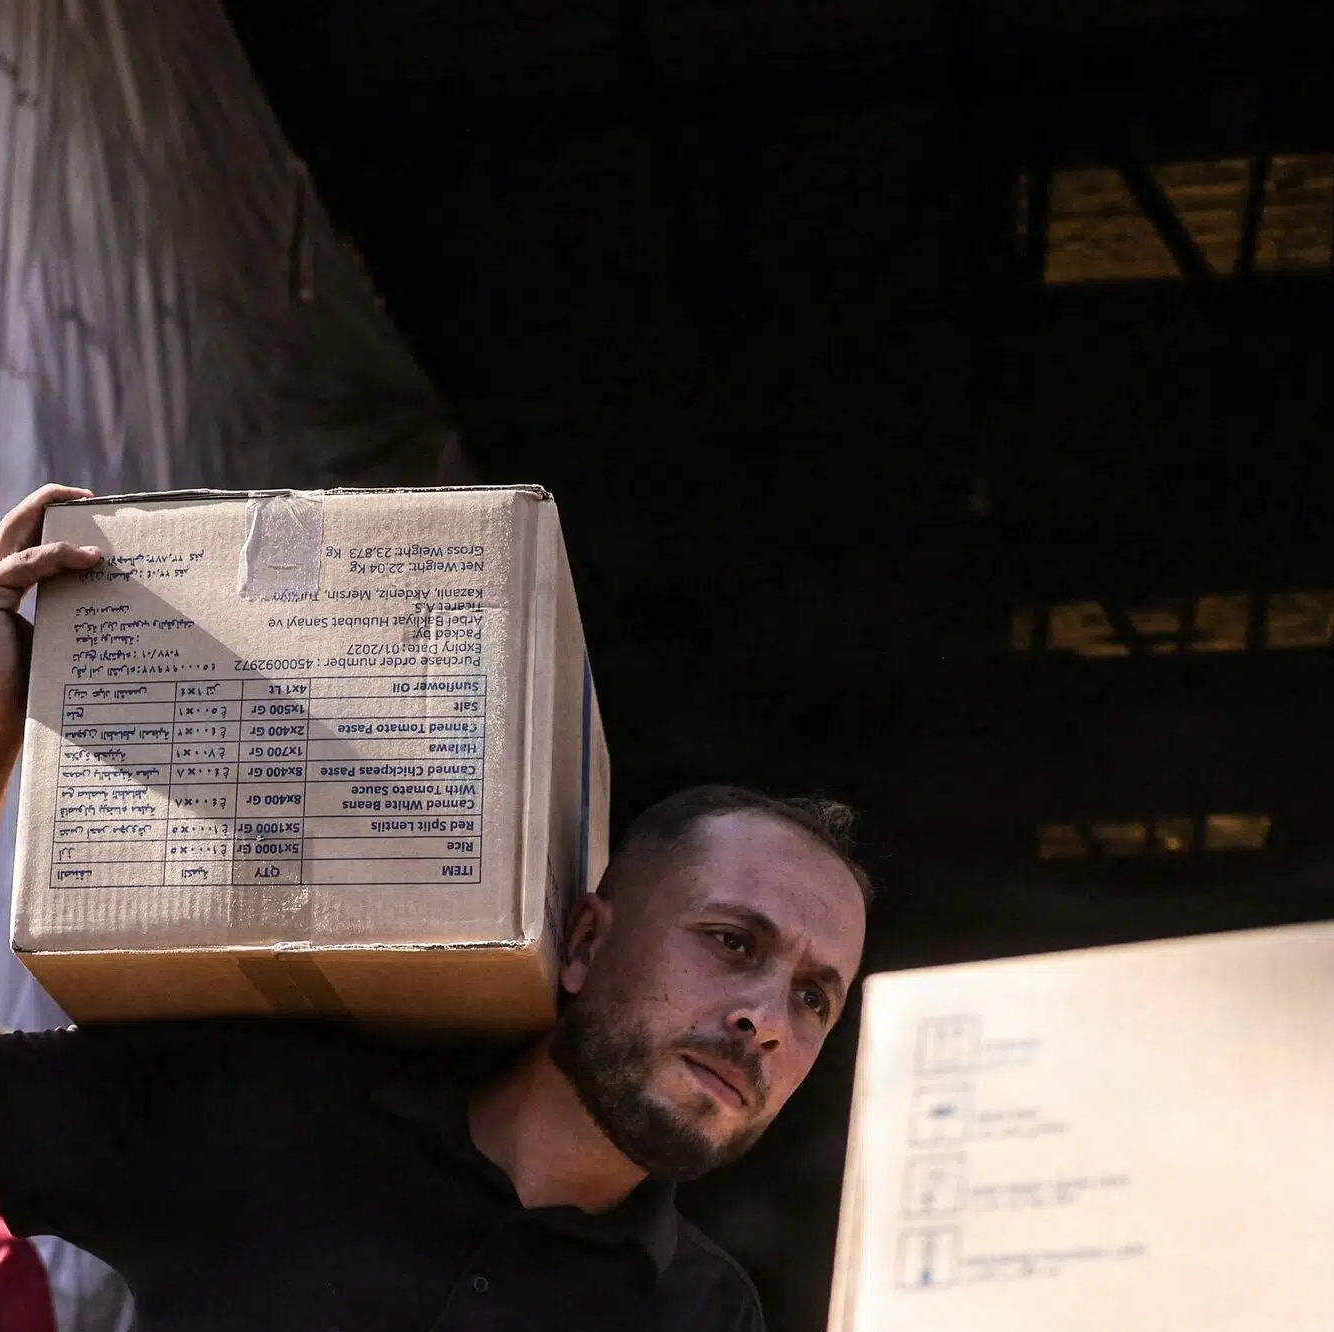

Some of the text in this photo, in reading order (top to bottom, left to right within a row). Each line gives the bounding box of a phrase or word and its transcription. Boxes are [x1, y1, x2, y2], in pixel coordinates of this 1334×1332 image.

[325, 544, 484, 559] Gross Weight: 23,873 Kg
[349, 561, 365, 574] Kg
[408, 559, 457, 573] Weight:
[459, 560, 484, 572] Net
[323, 589, 371, 601] Mersin,
[375, 589, 430, 600] Akdeniz,
[267, 618, 283, 628] ve
[331, 615, 389, 628] Hububat
[392, 613, 443, 626] Bakliyat
[447, 614, 483, 627] Arbel
[411, 626, 481, 640] Packed by:
[346, 643, 399, 655] 01/2027
[441, 640, 482, 654] Expiry
[233, 657, 313, 670] 4500092972
[323, 657, 376, 668] number
[379, 656, 416, 667] order
[420, 655, 481, 667] Purchase
[268, 684, 307, 694] 4x1 Lt
[392, 681, 479, 693] Sunflower Oil
[250, 704, 305, 714] 1x500 Gr
[452, 701, 478, 711] Salt
[249, 725, 304, 736] 2x400 Gr
[337, 722, 477, 734] Canned Tomato Paste
[248, 745, 303, 756] 1x700 Gr
[428, 743, 476, 753] Halawa
[247, 766, 303, 777] 8x400 Gr
[320, 762, 476, 777] Canned Chickpeas Paste
[350, 784, 475, 796] With Tomato Sauce
[246, 793, 301, 805] 8x400 Gr
[341, 799, 475, 811] Canned White Beans
[237, 822, 300, 834] 5x1000 Gr
[370, 818, 474, 833] Red Split Lentils
[236, 843, 299, 854] 5x1000 Gr
[446, 840, 474, 852] Rice
[56, 869, 92, 879] الصنف
[180, 867, 209, 878] الكمية
[254, 865, 280, 877] QTY
[441, 864, 473, 875] ITEM
